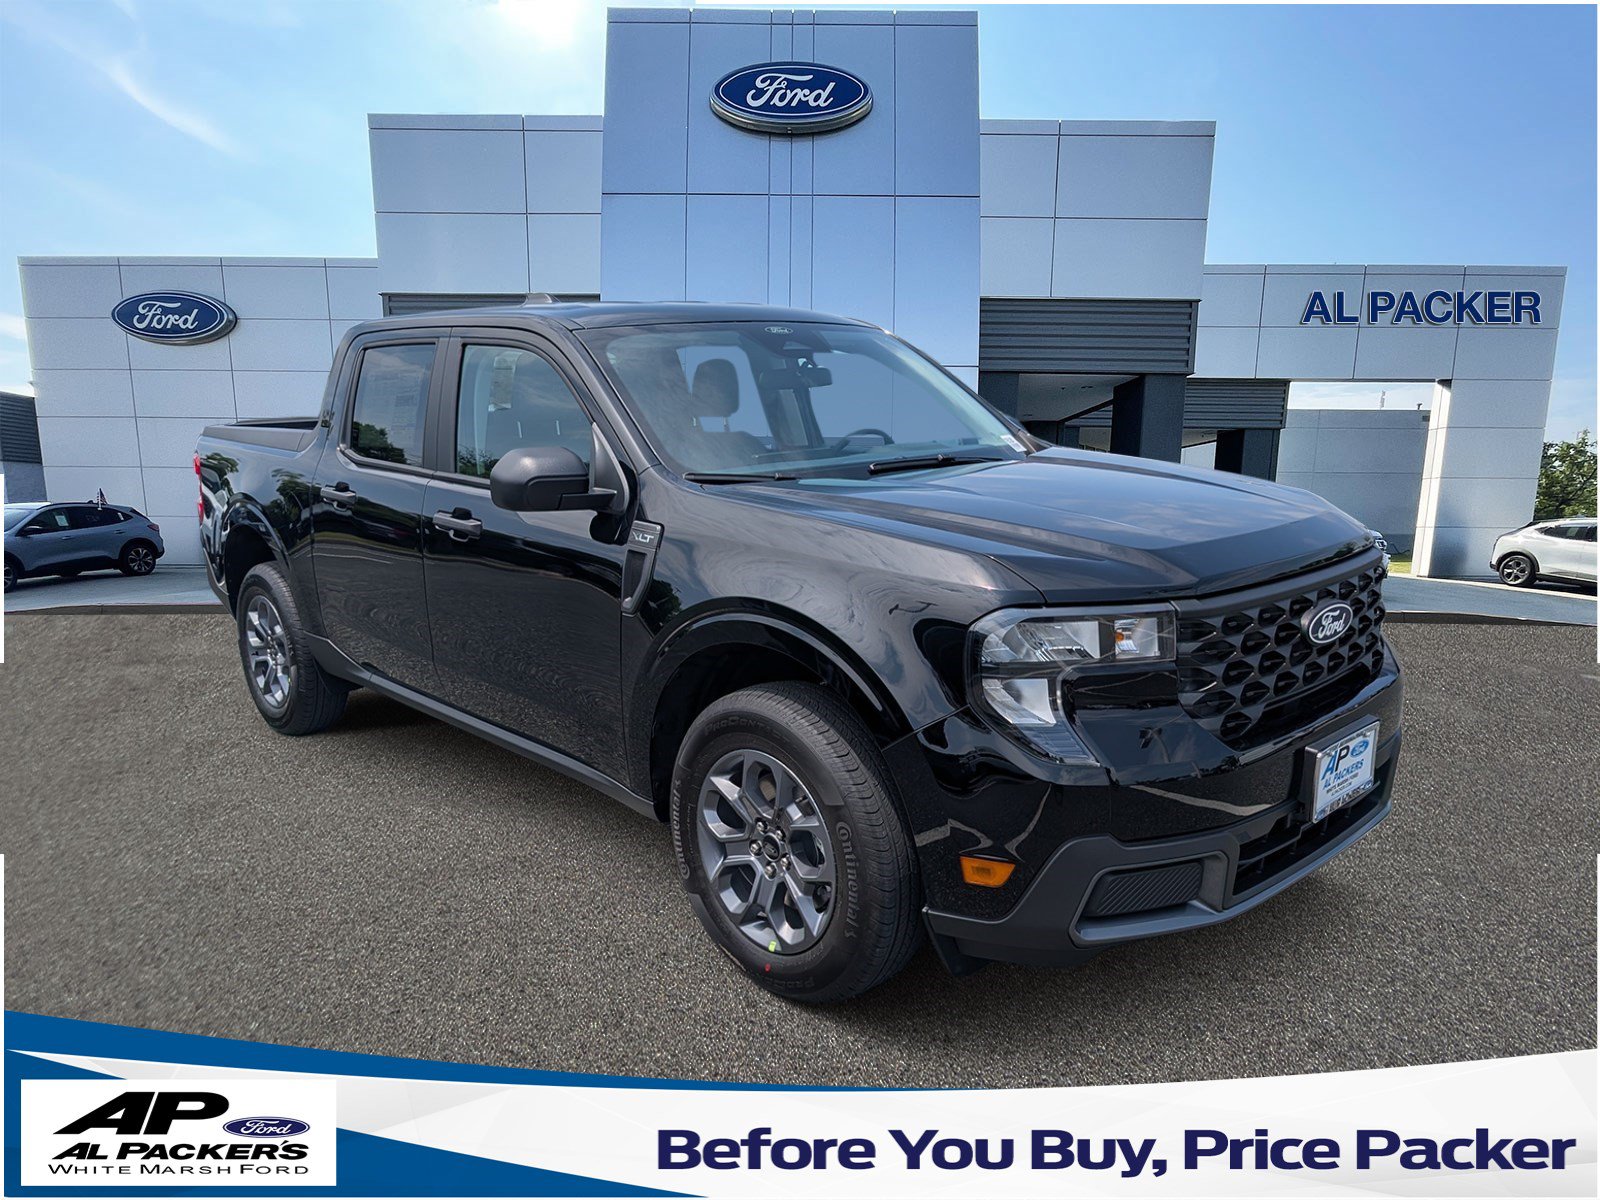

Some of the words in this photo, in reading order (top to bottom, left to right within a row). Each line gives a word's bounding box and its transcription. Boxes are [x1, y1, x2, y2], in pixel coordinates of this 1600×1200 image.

[746, 73, 836, 107] Ford
[133, 301, 198, 329] Ford
[1302, 290, 1359, 323] AL
[1368, 290, 1542, 324] PACKER
[1317, 609, 1346, 639] Ford
[1321, 745, 1350, 780] AP
[836, 821, 860, 929] Continental
